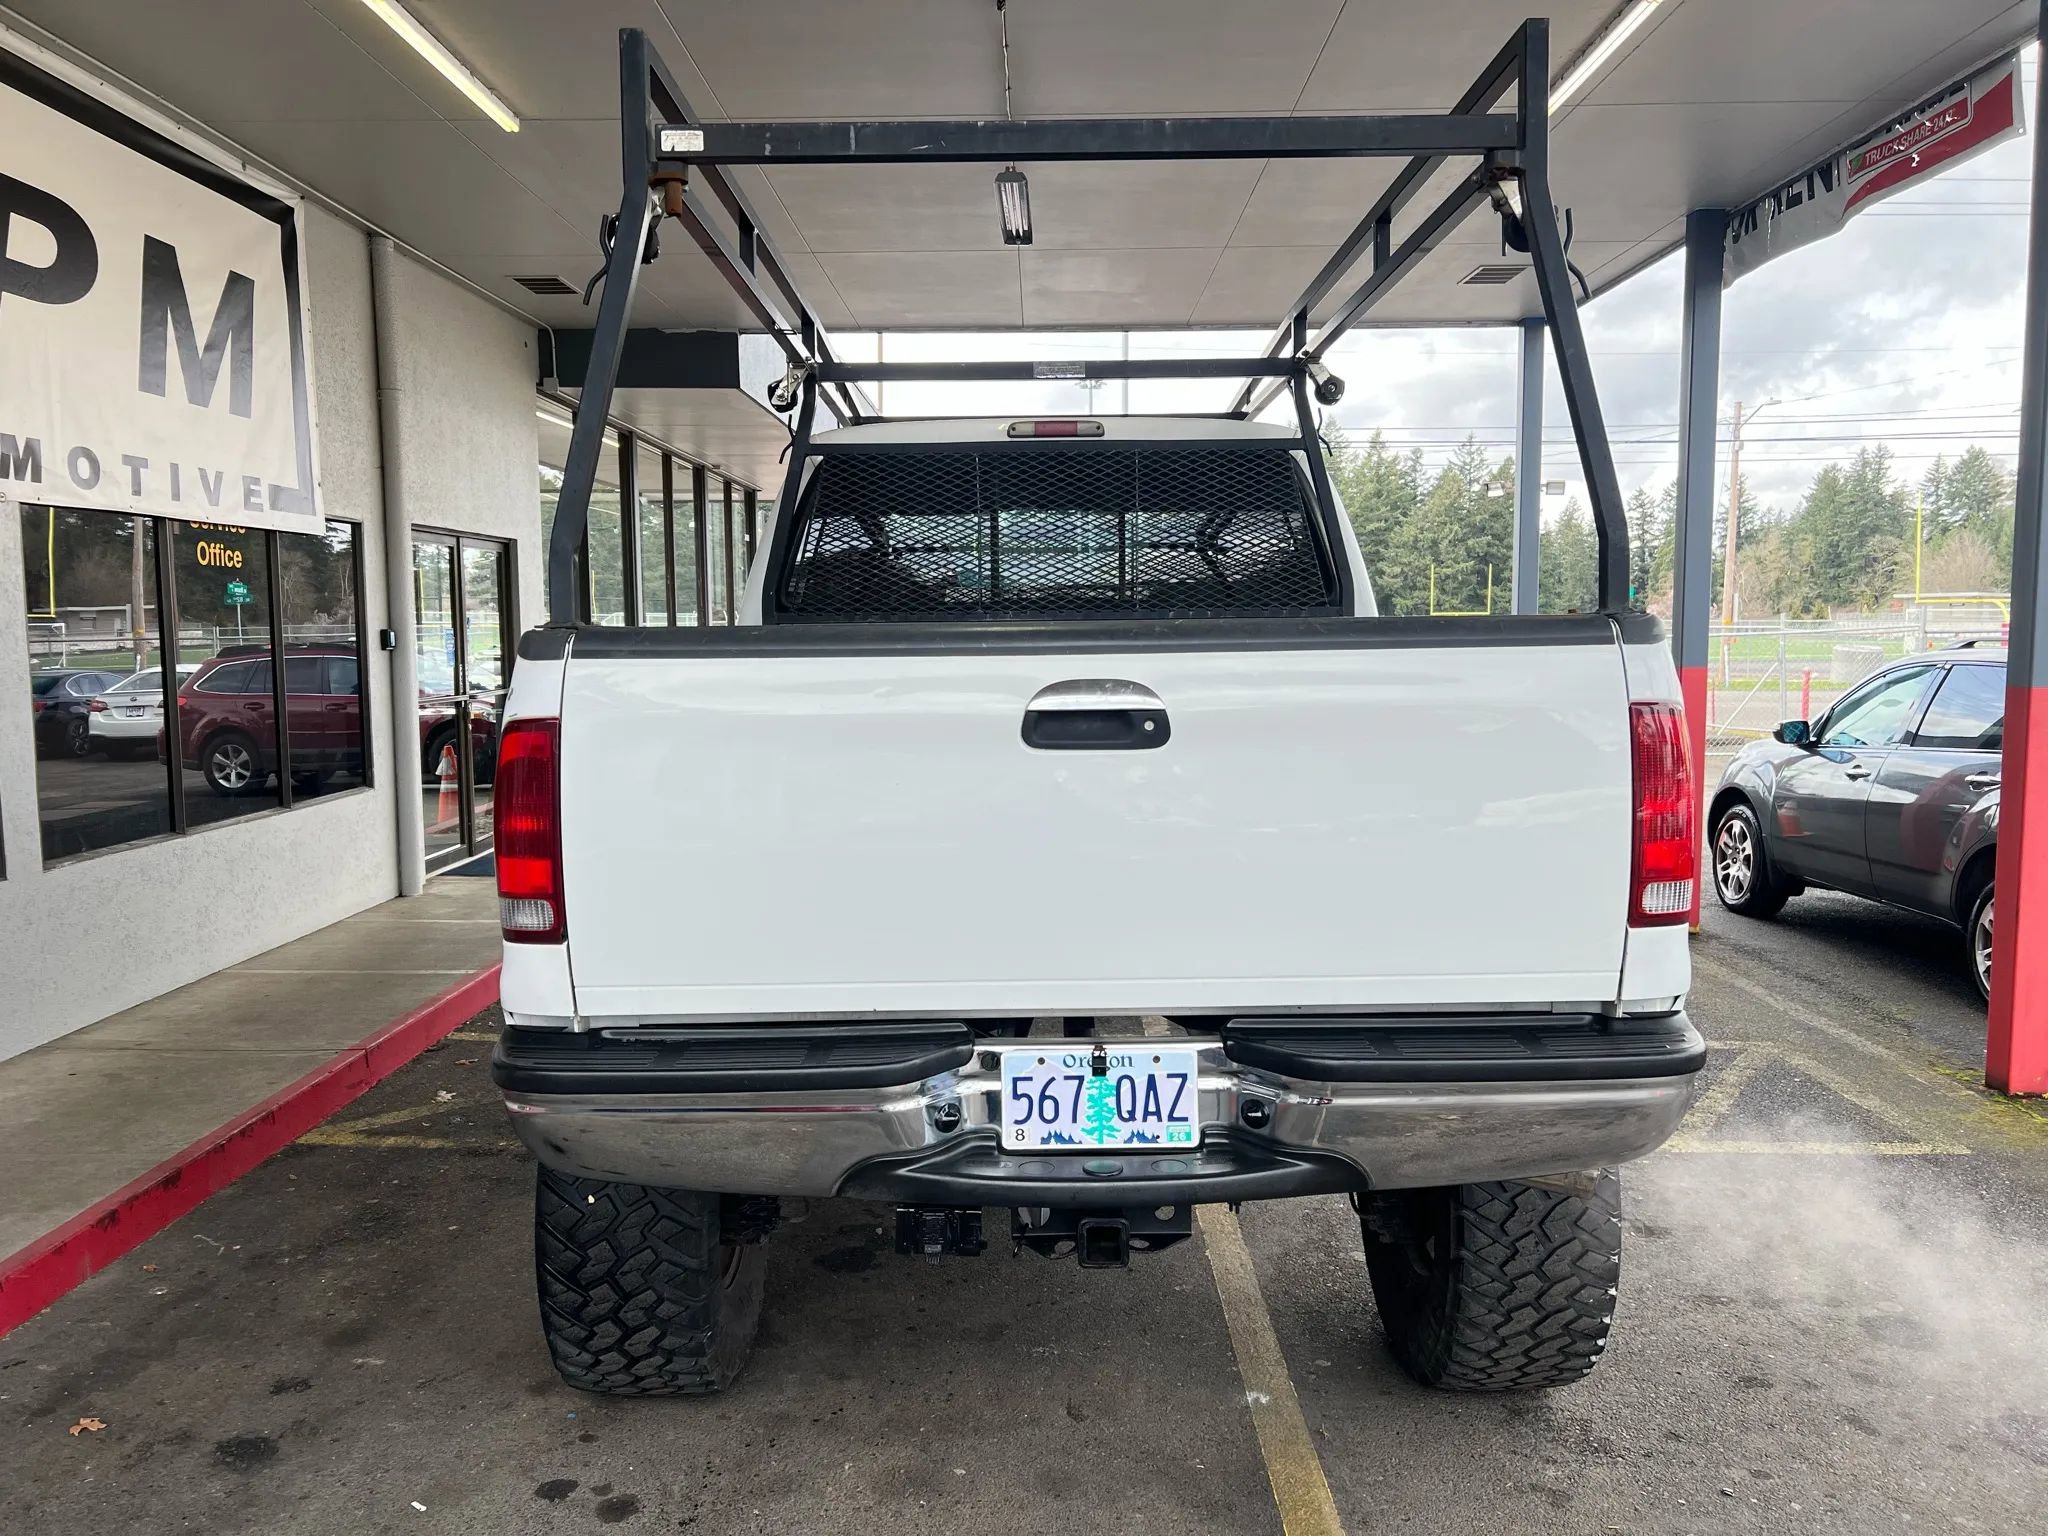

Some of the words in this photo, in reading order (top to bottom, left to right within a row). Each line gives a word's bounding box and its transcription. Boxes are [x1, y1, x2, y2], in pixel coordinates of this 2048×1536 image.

[0, 433, 264, 512] MOTIVE
[196, 541, 243, 568] Office
[1063, 1054, 1135, 1069] Oreon
[1012, 1075, 1085, 1125] 567
[1115, 1073, 1189, 1123] QAZ
[1015, 1129, 1025, 1141] 8
[1172, 1132, 1186, 1141] 26
